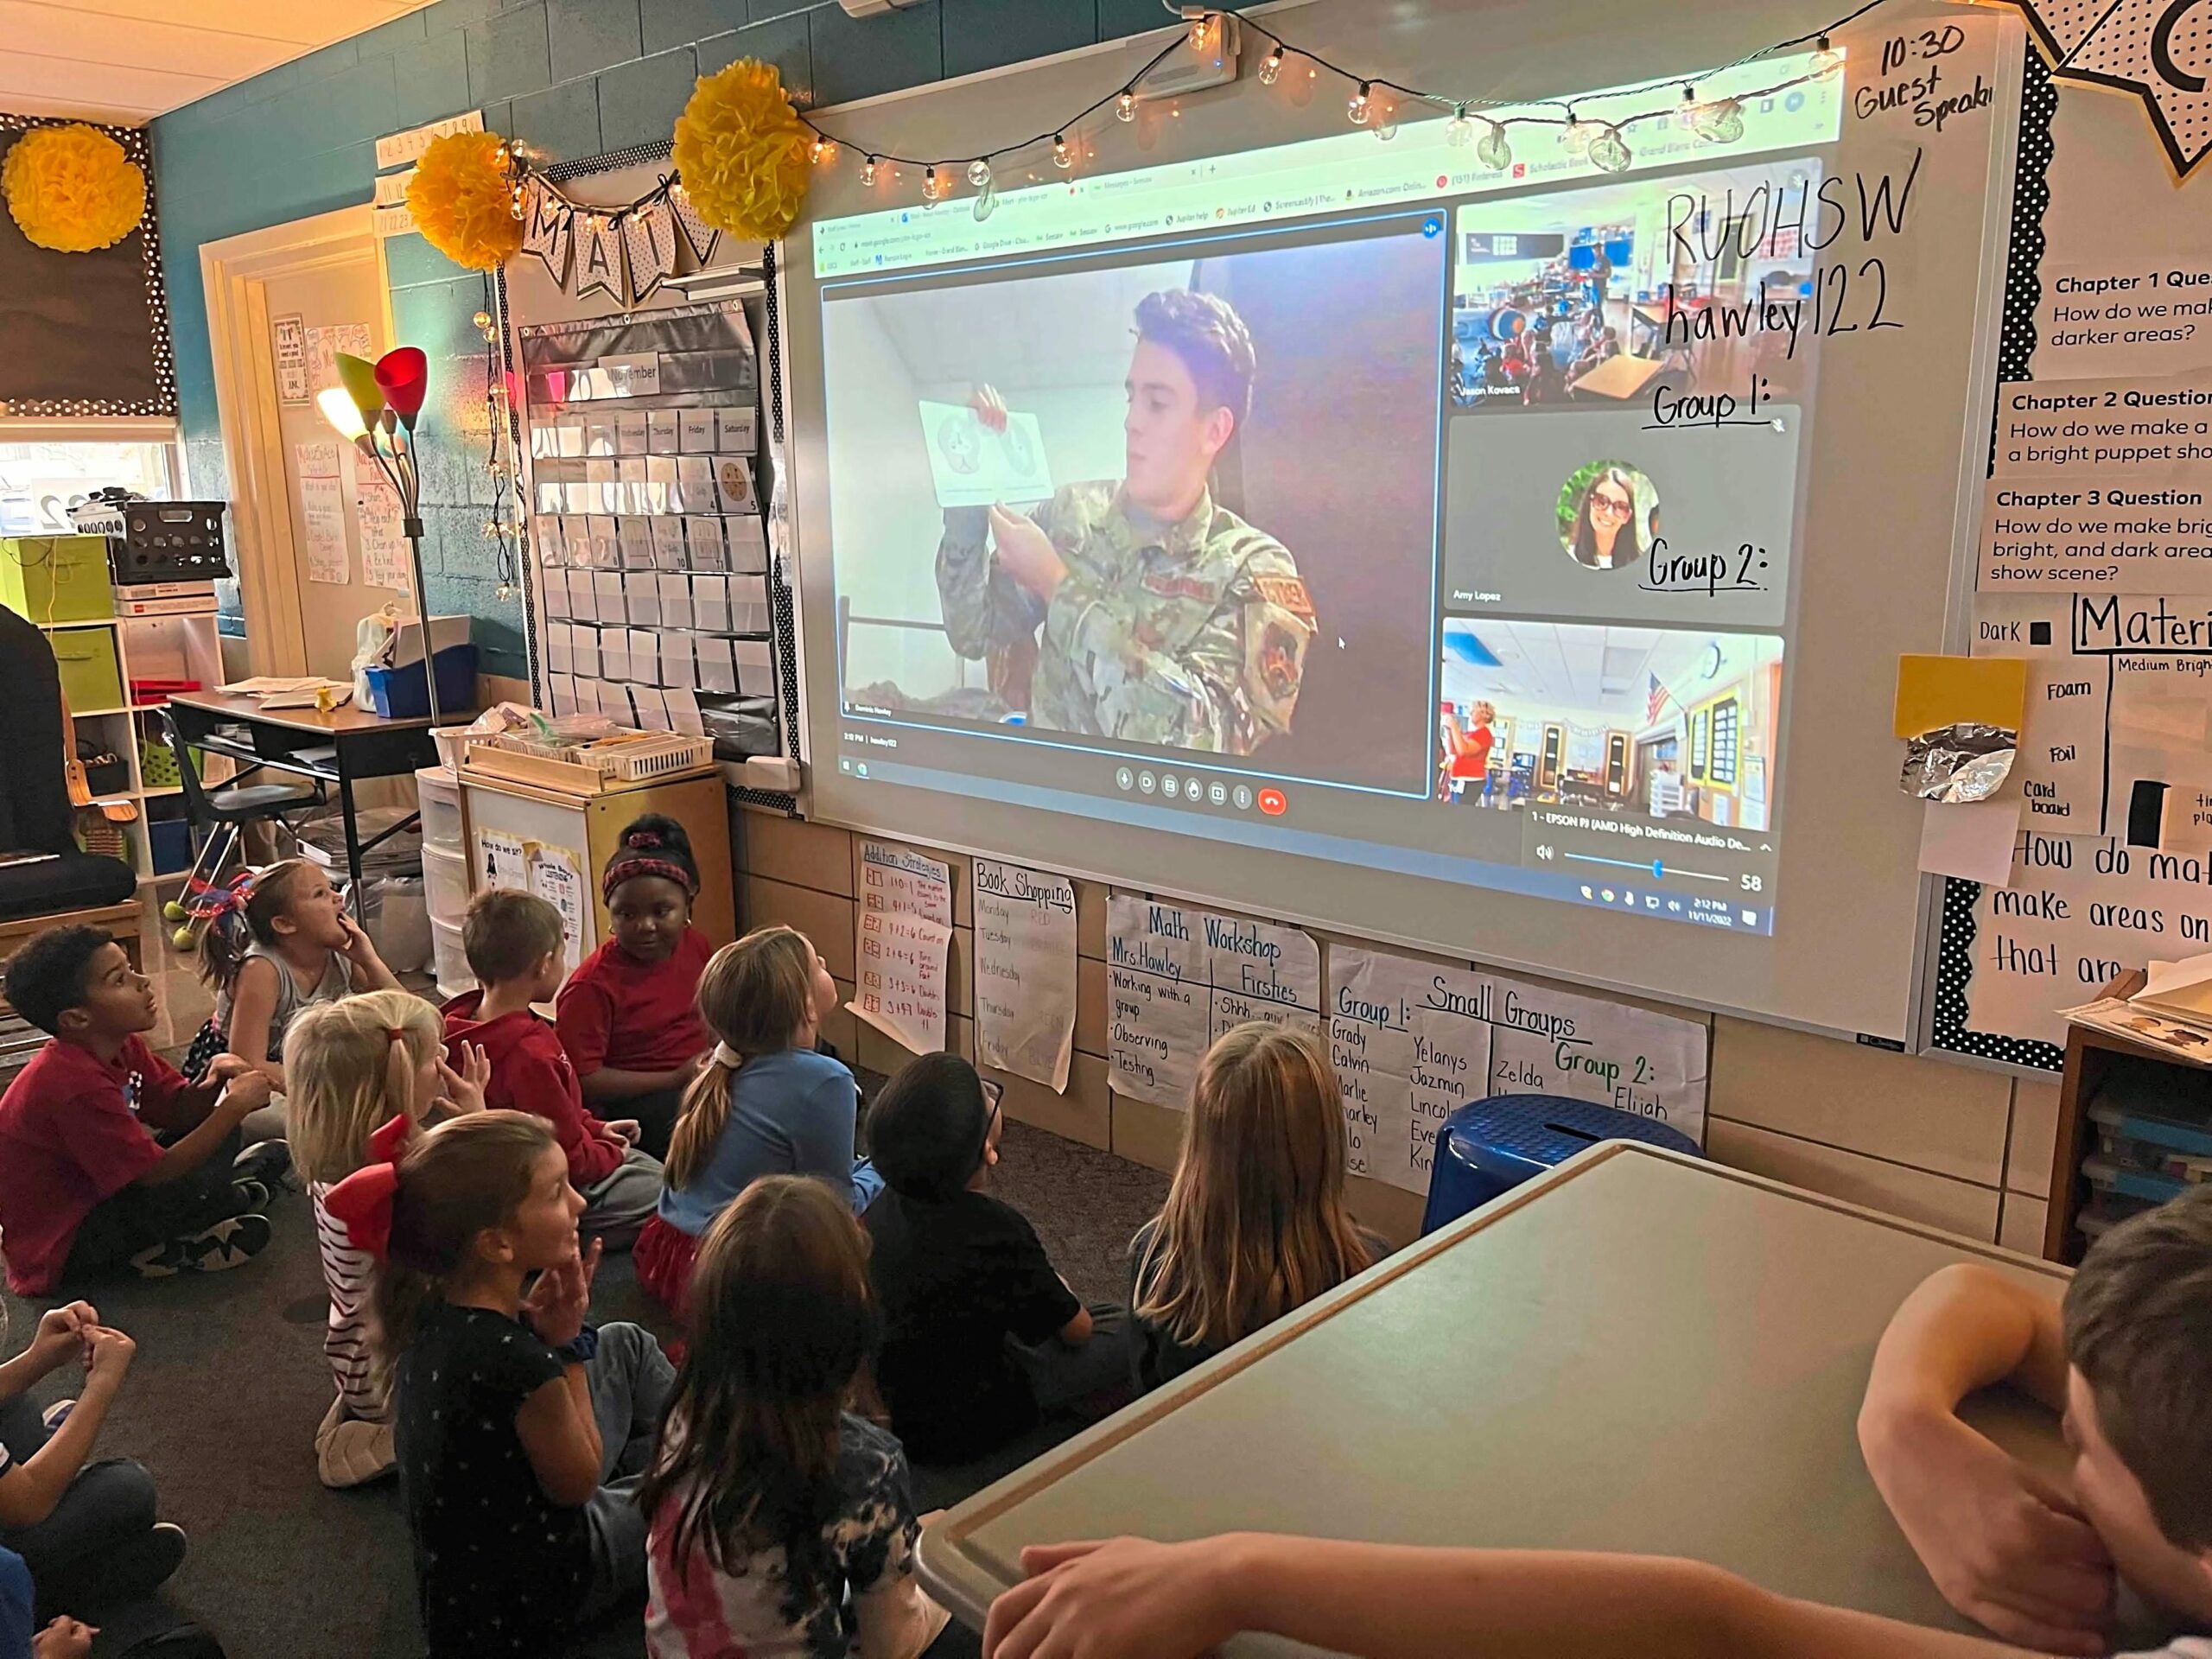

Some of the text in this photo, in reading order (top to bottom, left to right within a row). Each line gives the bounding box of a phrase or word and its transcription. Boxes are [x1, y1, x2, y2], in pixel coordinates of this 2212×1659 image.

[1881, 25, 1965, 76] 10:30
[1854, 65, 1942, 119] Guest
[531, 185, 661, 277] MAT
[2055, 270, 2212, 296] Chapter 1 Que
[2053, 306, 2101, 323] How
[2105, 302, 2132, 321] do
[2137, 305, 2168, 318] we
[2050, 323, 2196, 346] darker areas?
[1653, 372, 1771, 429] Group 1:
[2012, 394, 2098, 413] Chapter
[2104, 391, 2118, 408] 2
[688, 424, 705, 435] Friday
[724, 423, 751, 435] Saturday
[2010, 417, 2208, 439] How do we make a
[2007, 442, 2212, 465] a bright puppet sho
[710, 499, 757, 511] 4 5
[1996, 489, 2202, 510] Chapter 3 Question
[1994, 518, 2041, 535] How
[2046, 518, 2073, 534] do
[2078, 521, 2108, 534] we
[2113, 517, 2171, 534] make
[677, 557, 724, 570] 10 11
[1993, 541, 2212, 561] bright, and dark area
[1649, 537, 1770, 598] Group 2:
[1990, 564, 2120, 582] show scene?
[1453, 588, 1502, 604] Amy Lopez
[2119, 658, 2212, 678] Medium Brigh
[2047, 681, 2091, 701] Foam
[2049, 745, 2076, 764] Foil
[2024, 780, 2056, 799] Card
[2031, 799, 2071, 817] board
[1546, 812, 1579, 827] EPSON
[1591, 818, 1618, 833] (AMD
[1619, 823, 1644, 838] High
[1644, 826, 1694, 844] Definition
[1694, 833, 1726, 849] Audio
[481, 839, 494, 850] How
[864, 843, 899, 866] Addition
[2094, 836, 2130, 875] do
[977, 861, 1072, 915] Book Shopping
[1740, 873, 1763, 893] 58
[978, 899, 1009, 926] Monday
[1712, 900, 1728, 912] PM
[1993, 890, 2209, 943] make areas on
[980, 927, 1011, 947] Tuesday
[1149, 906, 1281, 967] Math Workshop
[1989, 934, 2061, 976] that
[1113, 970, 1152, 1002] Working
[1158, 985, 1181, 1002] with
[1242, 963, 1298, 1003] Firsties
[980, 997, 1014, 1022] Thursday
[1116, 999, 1141, 1023] group
[1339, 986, 1390, 1031] Group
[1426, 976, 1576, 1044] Small Groups
[1114, 1022, 1168, 1060] Observing
[1332, 1019, 1367, 1055] Grady
[1114, 1048, 1155, 1086] Testing
[1332, 1044, 1370, 1075] Calvin
[1413, 1035, 1468, 1076] Yelanys
[1555, 1040, 1655, 1094] Group 2:
[1409, 1065, 1465, 1100] Jazmin
[1496, 1059, 1544, 1090] Zelda
[1410, 1091, 1453, 1120] Lincol
[1613, 1085, 1669, 1121] Elijah
